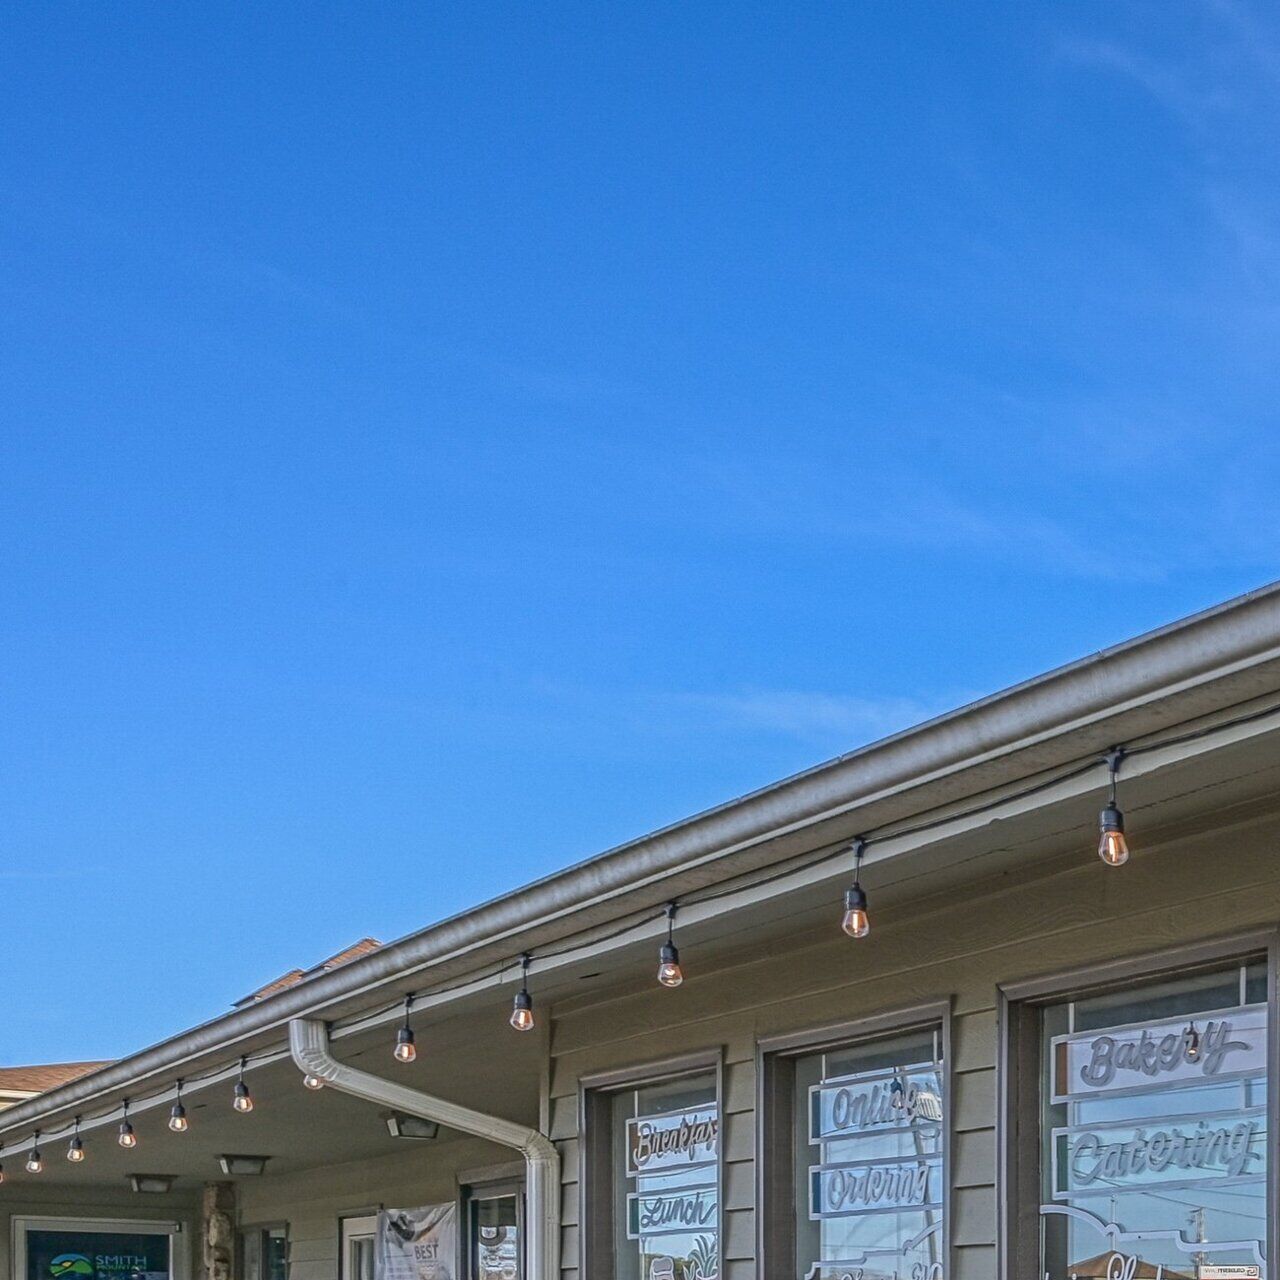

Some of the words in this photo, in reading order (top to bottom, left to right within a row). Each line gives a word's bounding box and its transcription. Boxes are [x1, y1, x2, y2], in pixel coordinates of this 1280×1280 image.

[1079, 1020, 1253, 1087] Bakery
[633, 1114, 718, 1167] Breakfas
[1071, 1121, 1261, 1186] Catering
[640, 1191, 718, 1229] Lunch
[827, 1164, 930, 1211] Ordering
[95, 1255, 147, 1266] SMITH
[414, 1243, 439, 1260] BEST
